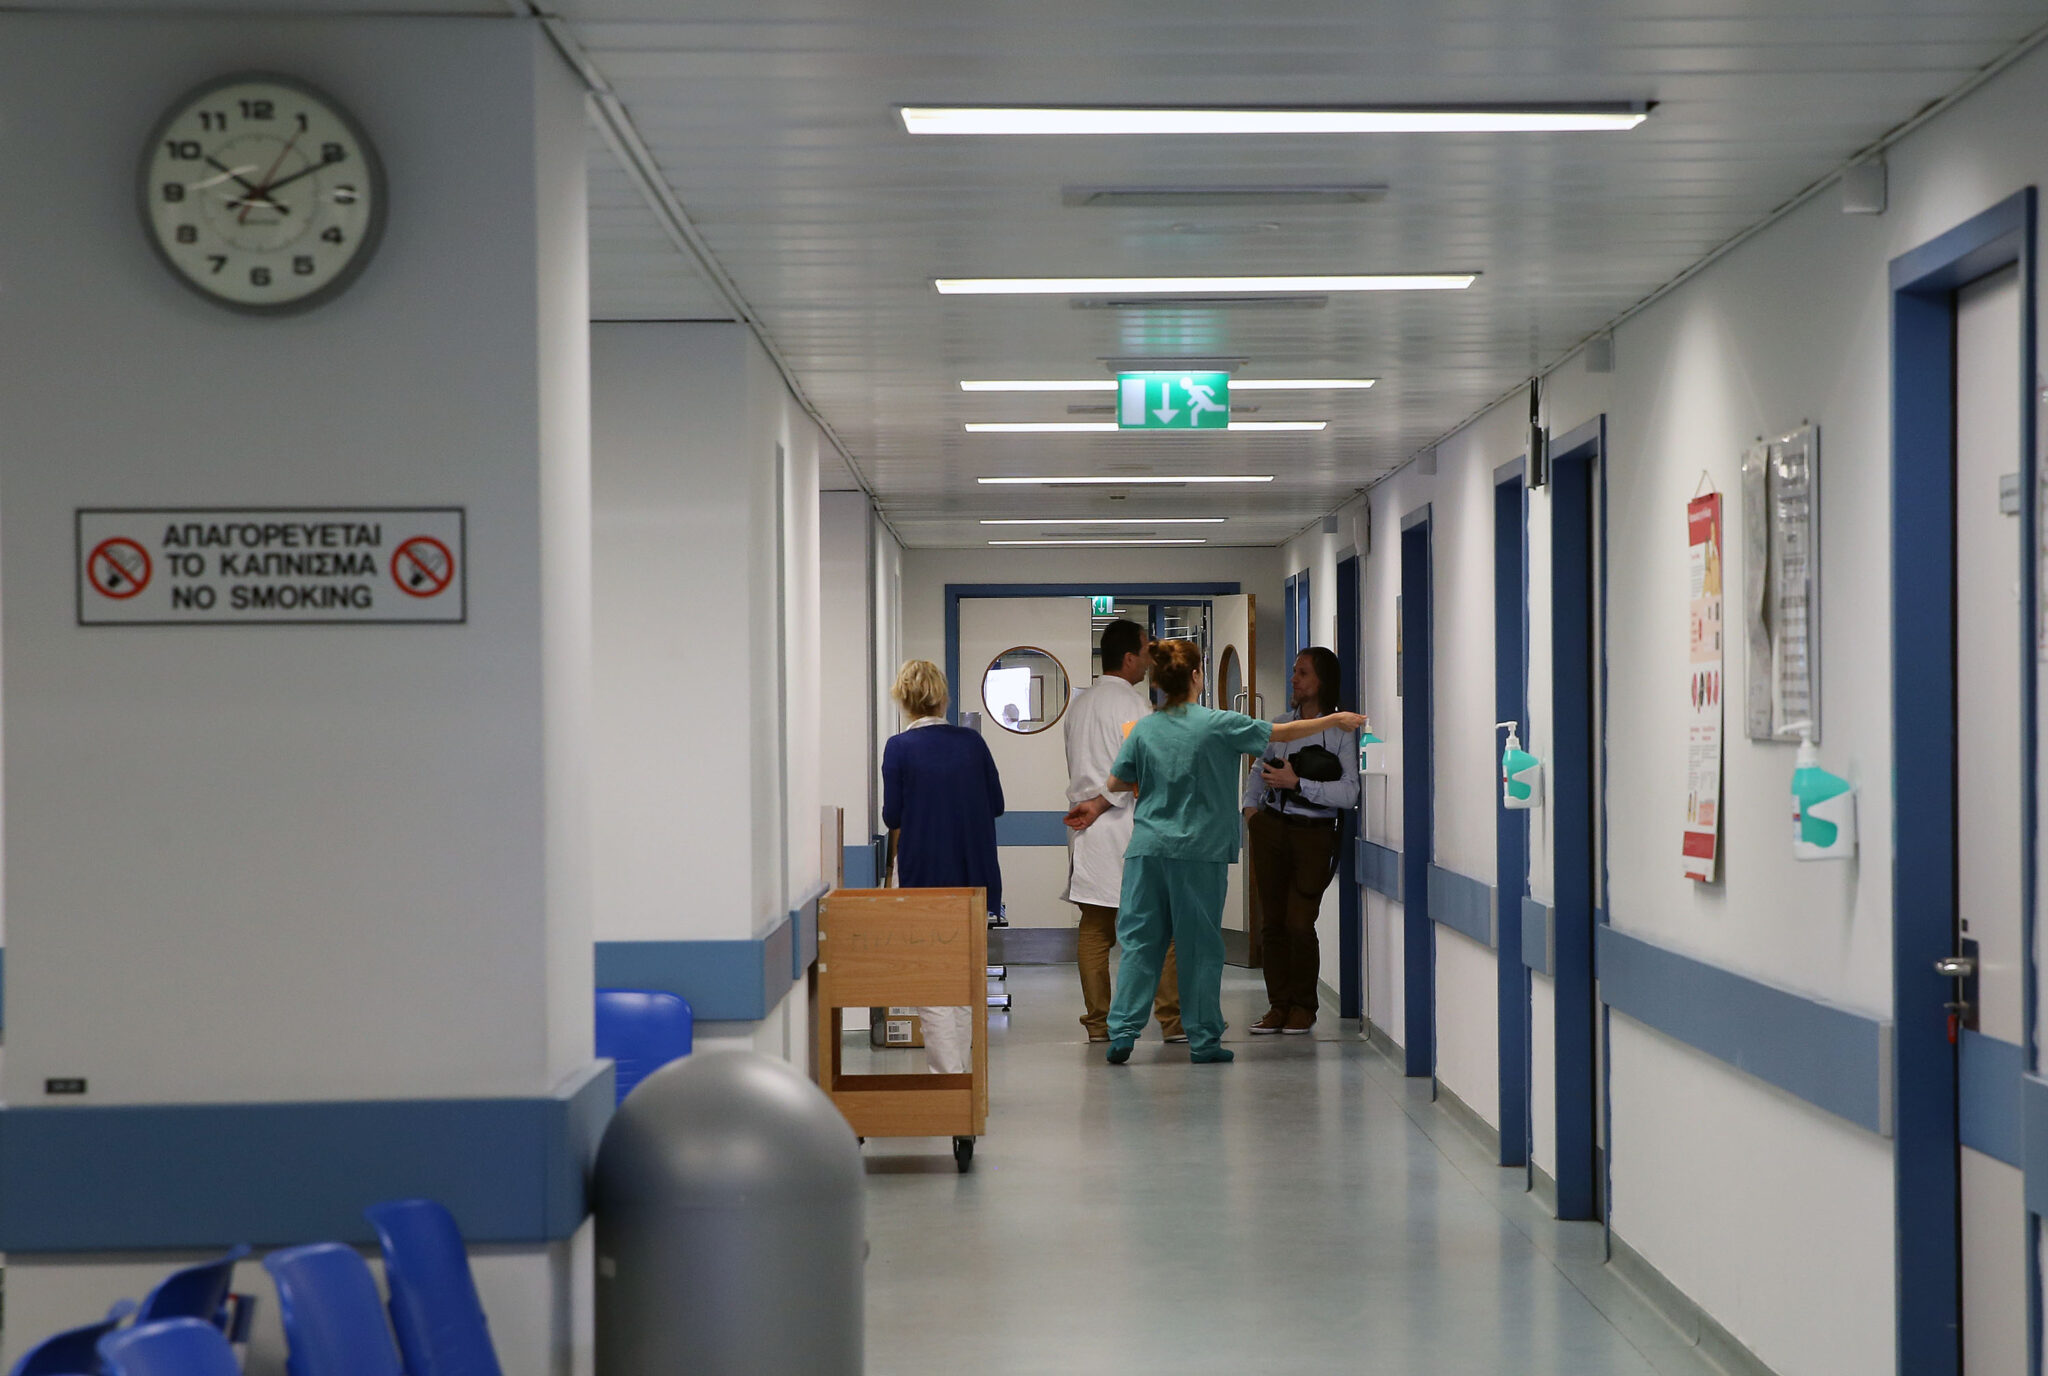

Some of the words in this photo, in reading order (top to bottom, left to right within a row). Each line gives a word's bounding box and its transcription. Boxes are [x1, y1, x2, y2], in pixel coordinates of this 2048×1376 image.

[238, 100, 275, 120] 12
[200, 111, 227, 132] 11
[296, 113, 308, 132] 1
[166, 141, 201, 160] 10
[321, 142, 346, 162] 2
[163, 183, 184, 202] 9
[176, 224, 198, 244] 8
[321, 227, 343, 245] 4
[207, 255, 228, 273] 7
[293, 255, 315, 275] 5
[250, 267, 271, 286] 6
[163, 523, 381, 547] ΑΠΑΓΟΡΕΥΕΤΑΙ
[167, 553, 205, 577] ΤΟ
[220, 552, 377, 577] ΚΑΠΝΙΣΜΑ
[171, 585, 216, 609] NO
[230, 585, 373, 609] SMOKING
